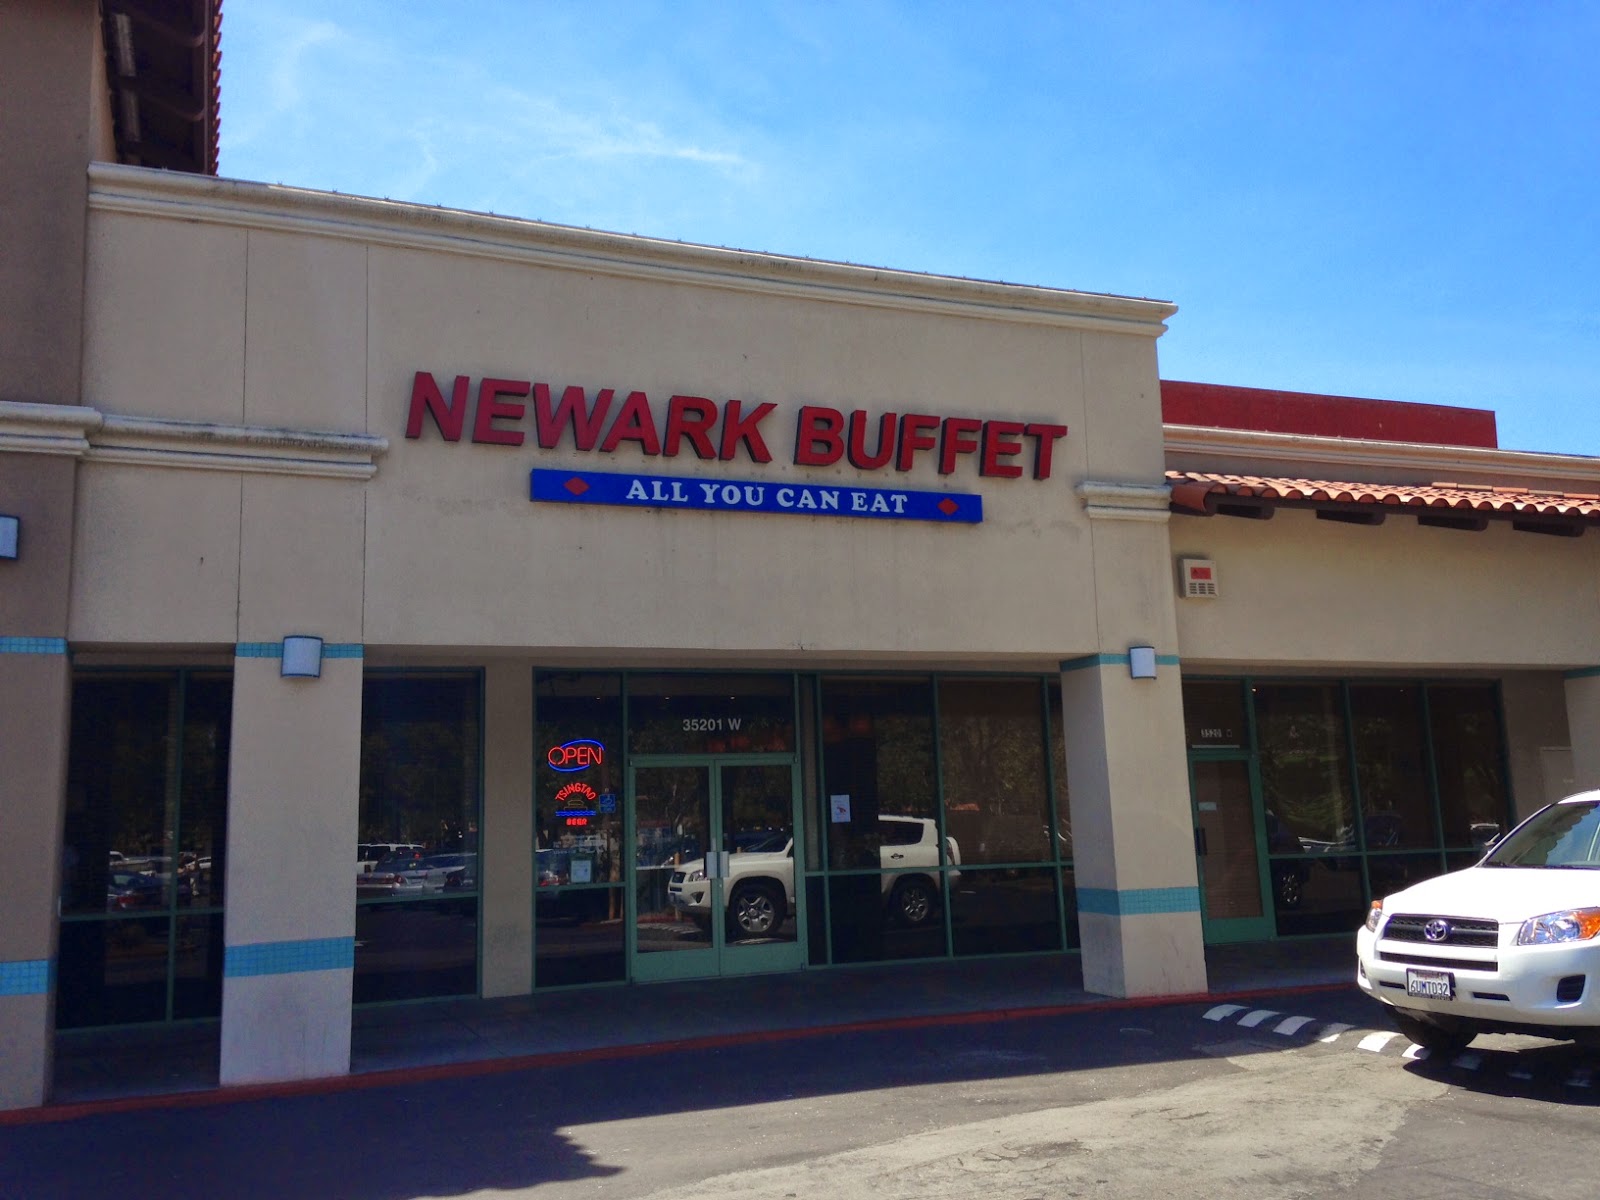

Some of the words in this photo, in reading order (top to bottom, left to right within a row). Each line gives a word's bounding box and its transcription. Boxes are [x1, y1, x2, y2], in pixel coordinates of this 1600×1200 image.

[405, 371, 778, 465] NEWARK
[793, 405, 1068, 480] BUFFET
[626, 479, 689, 502] ALL
[699, 483, 764, 506] YOU
[776, 488, 840, 510] CAN
[851, 492, 908, 514] EAT
[682, 719, 722, 731] 35201
[727, 718, 742, 730] W
[548, 746, 602, 765] OPEN
[555, 782, 597, 801] TSINGTAO
[1410, 980, 1448, 996] 6UMT032
